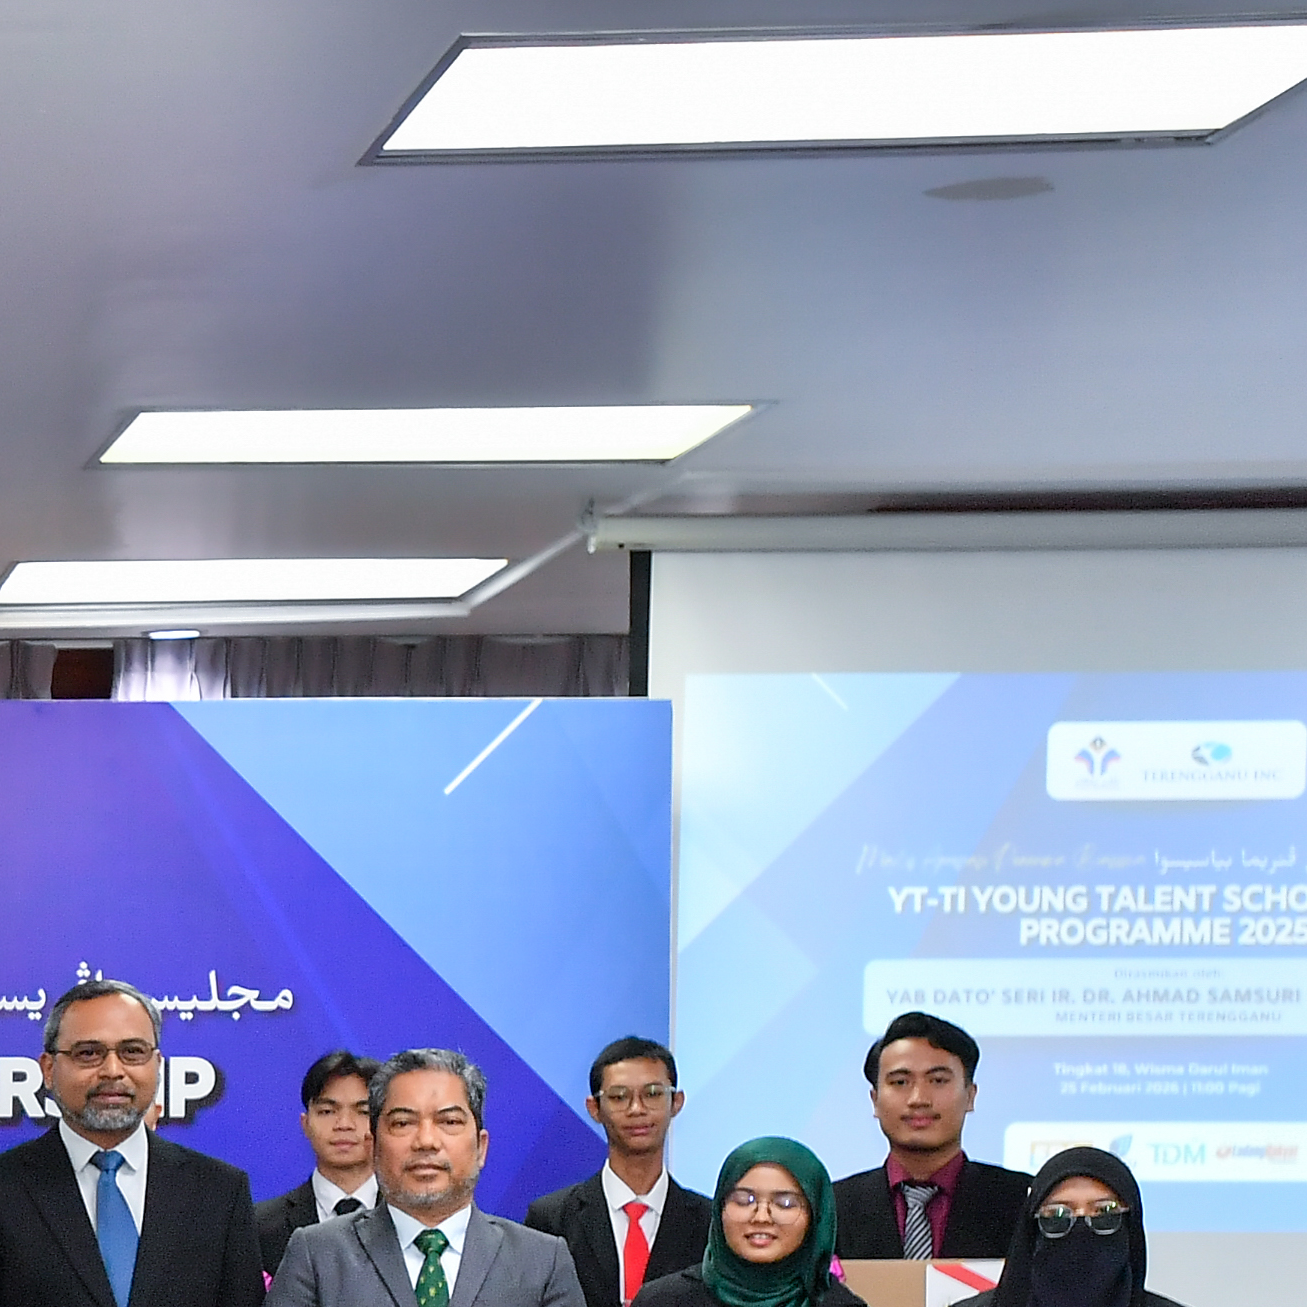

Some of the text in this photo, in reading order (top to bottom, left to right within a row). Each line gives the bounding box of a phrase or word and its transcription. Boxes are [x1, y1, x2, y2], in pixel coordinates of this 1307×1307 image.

[888, 885, 965, 913] YT-TI
[972, 885, 1086, 913] YOUNG
[1095, 885, 1216, 913] TALENT
[1020, 917, 1307, 946] PROGRAMME 2025
[887, 988, 926, 1006] YAB
[1002, 988, 1045, 1006] SERI
[1083, 988, 1114, 1006] DR.
[1123, 988, 1200, 1006] AHMAD
[1207, 988, 1300, 1006] SAMSURI
[1056, 1011, 1121, 1022] MENTERI
[1178, 1011, 1282, 1023] TERENGGANU
[1054, 1062, 1108, 1078] Tingkat
[1232, 1062, 1269, 1076] Iman
[1081, 1080, 1142, 1095] Februari
[1148, 1142, 1206, 1166] TDM
